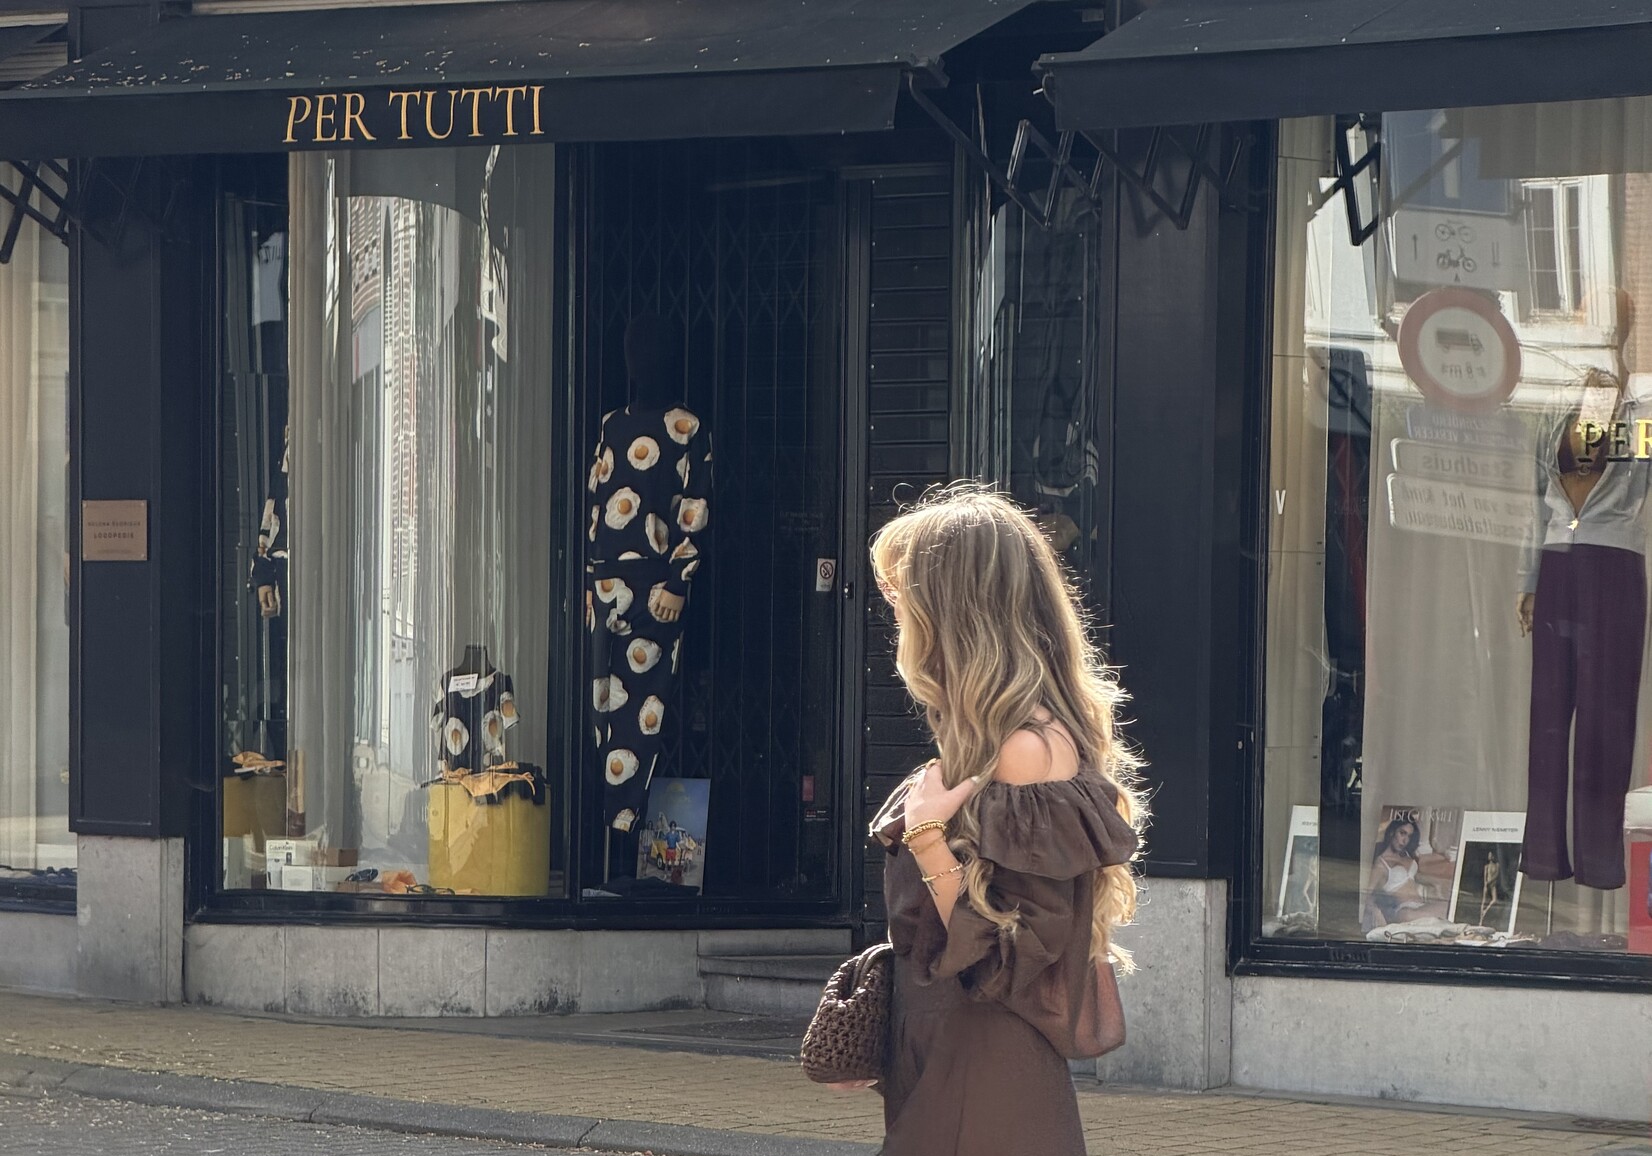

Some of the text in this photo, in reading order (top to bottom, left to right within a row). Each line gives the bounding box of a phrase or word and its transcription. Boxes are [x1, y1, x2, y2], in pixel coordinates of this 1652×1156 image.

[282, 85, 545, 143] PER TUTTI
[1576, 419, 1652, 461] PER
[1275, 489, 1287, 515] V
